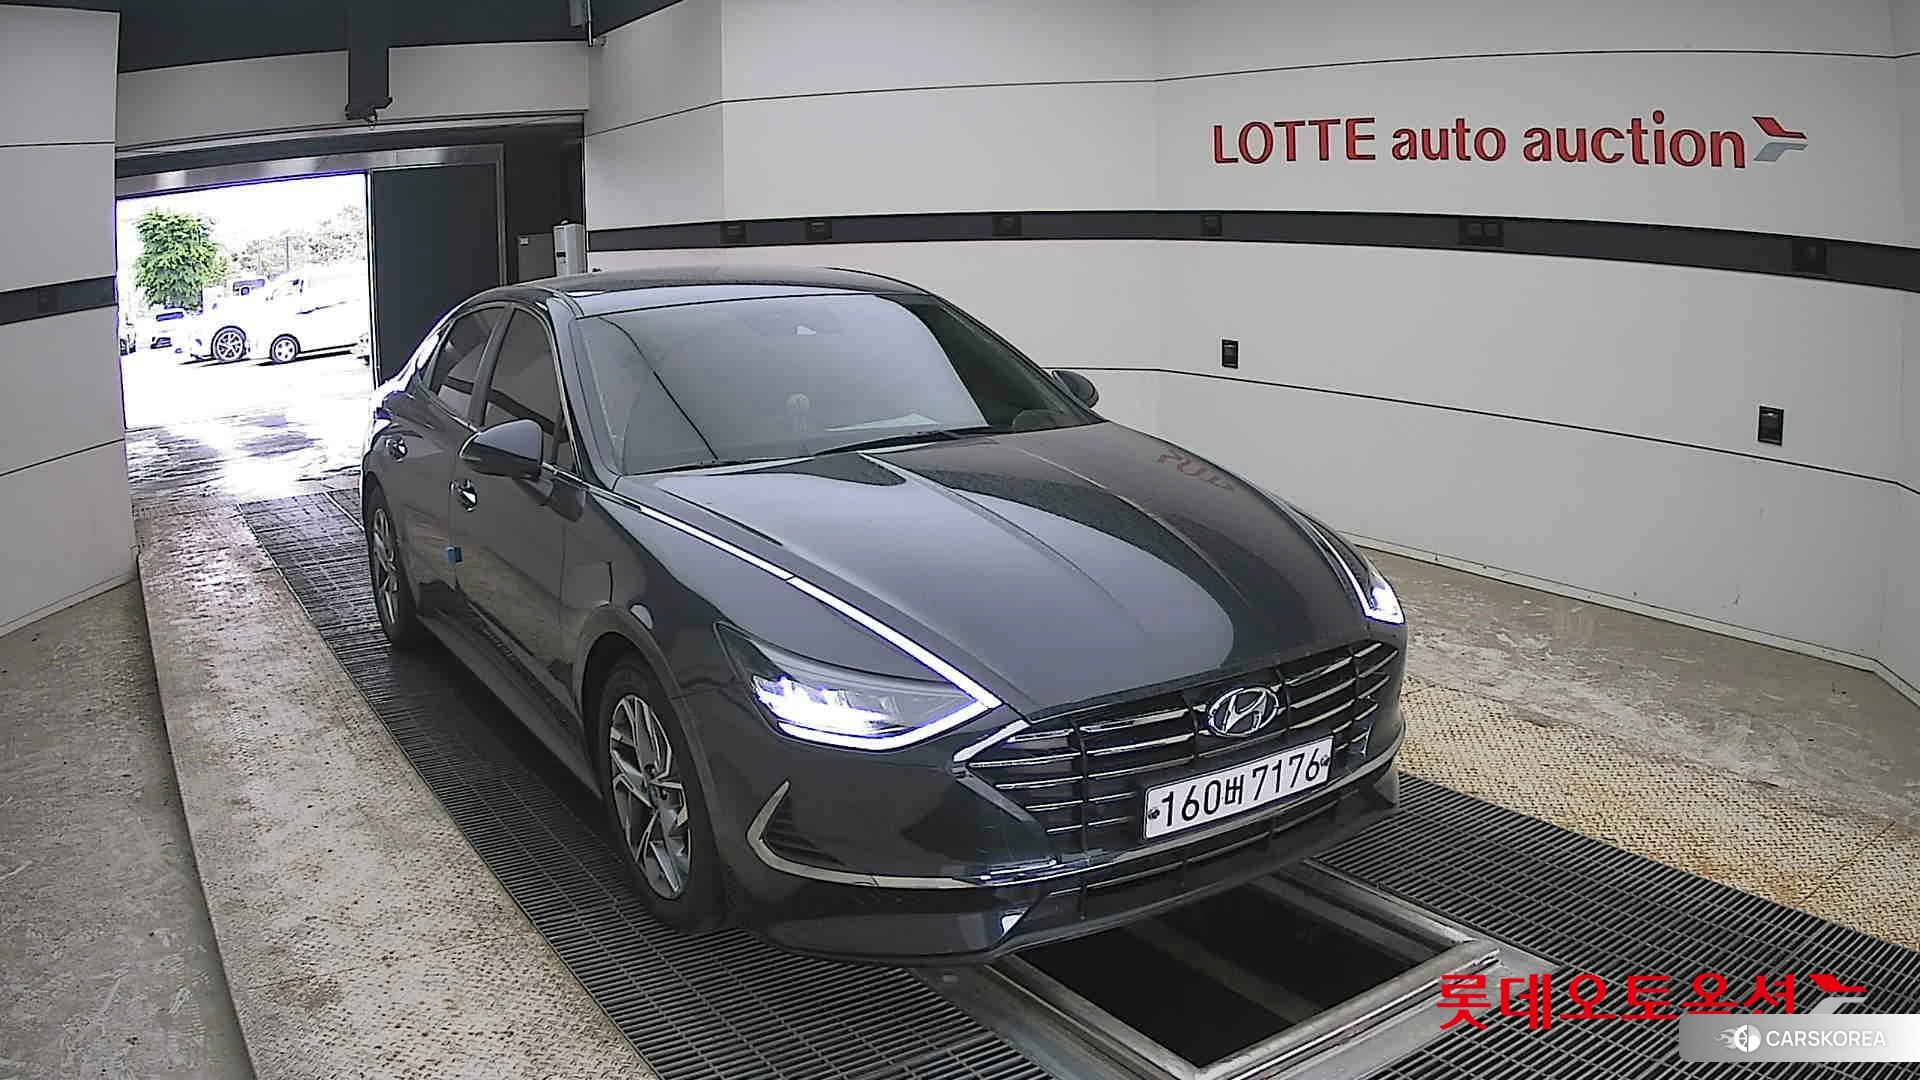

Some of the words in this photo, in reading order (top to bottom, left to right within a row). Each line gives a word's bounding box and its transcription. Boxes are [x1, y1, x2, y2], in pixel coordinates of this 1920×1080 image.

[1213, 117, 1376, 164] LOTTE
[1391, 118, 1507, 162] auto
[1523, 110, 1747, 169] auction
[1252, 747, 1321, 801] 7176
